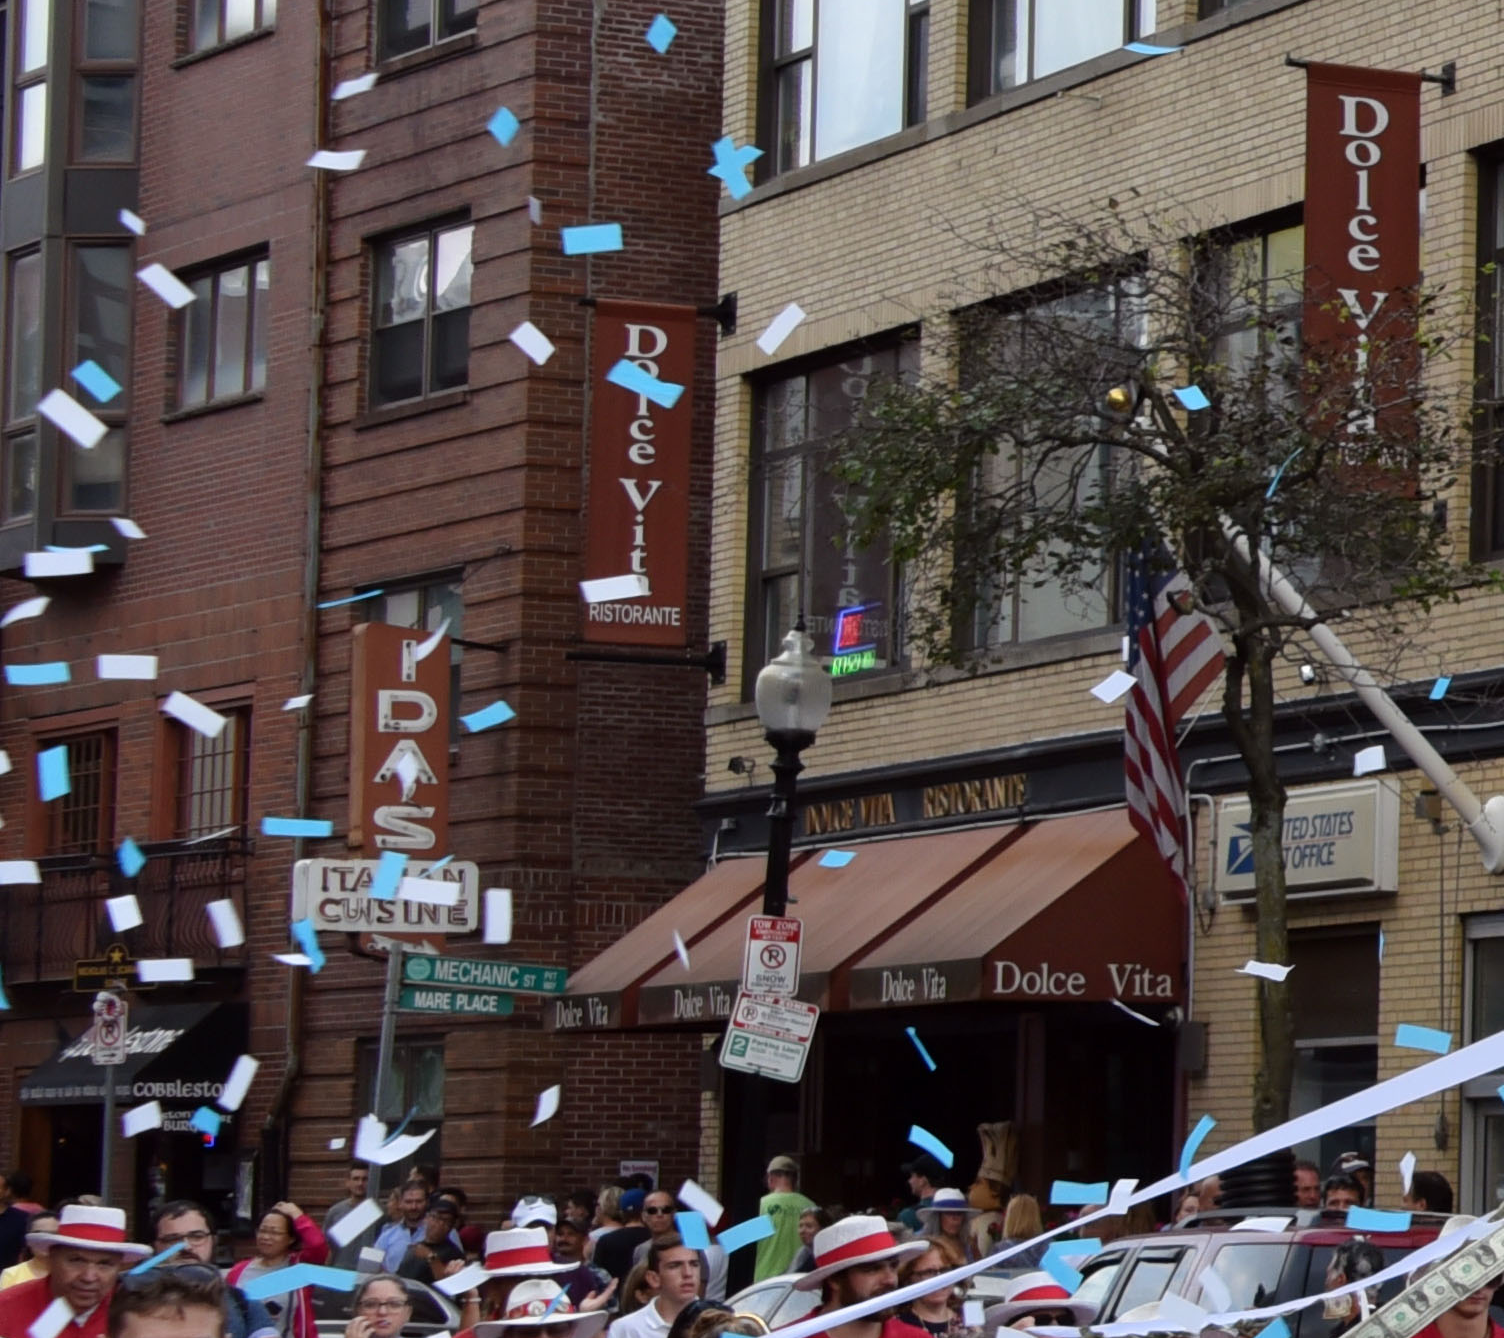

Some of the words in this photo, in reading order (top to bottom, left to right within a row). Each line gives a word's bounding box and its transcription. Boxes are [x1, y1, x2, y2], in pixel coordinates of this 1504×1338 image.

[1337, 94, 1390, 272] Dolce
[588, 602, 681, 626] RISTORANTE
[923, 773, 1027, 819] RISTORANTE
[1309, 810, 1355, 839] STATES
[1292, 842, 1336, 869] OFFICE
[320, 866, 467, 893] ITAN
[318, 898, 470, 925] CUISINE
[753, 920, 772, 930] TOW
[776, 920, 800, 931] ZONE
[434, 959, 520, 987] MECHANIC
[523, 974, 536, 988] ST
[881, 970, 916, 1002] Dolce
[918, 967, 947, 1000] Vita
[993, 960, 1087, 997] Dolce
[1107, 963, 1174, 998] Vita
[414, 991, 452, 1010] MARE
[456, 993, 499, 1012] PLACE
[555, 992, 584, 1029] Dolce
[587, 990, 609, 1025] Vita
[673, 987, 702, 1021] Dolce
[703, 982, 731, 1018] Vita
[732, 1038, 745, 1051] 2
